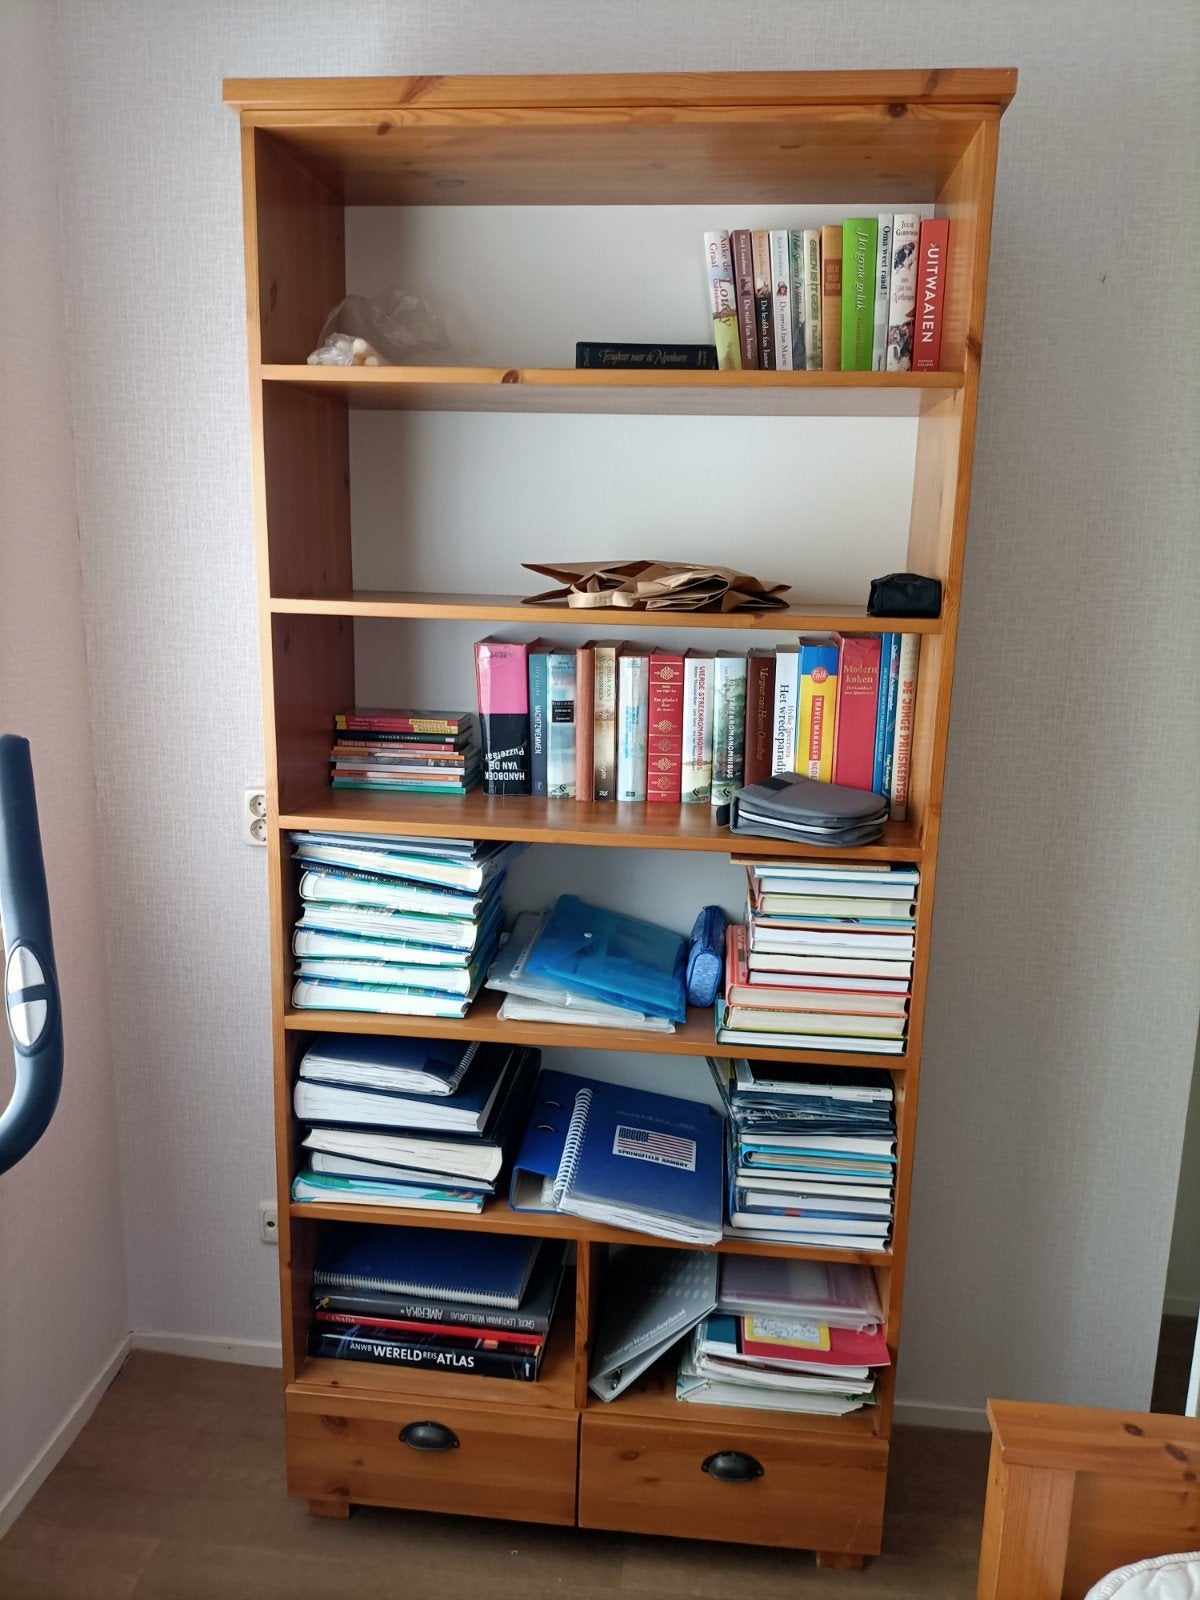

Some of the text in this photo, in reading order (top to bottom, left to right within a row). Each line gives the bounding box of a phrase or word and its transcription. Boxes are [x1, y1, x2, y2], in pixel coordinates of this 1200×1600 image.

[881, 226, 891, 247] Oma
[709, 242, 720, 269] Graaf
[719, 235, 734, 273] Anke de
[809, 239, 818, 270] GRIEN
[881, 248, 889, 268] weet
[855, 254, 865, 280] grote
[880, 269, 888, 290] raad
[743, 299, 752, 310] De
[855, 282, 867, 312] geluk
[922, 247, 940, 343] UITWAAIEN
[779, 300, 787, 311] De
[745, 324, 754, 336] fan
[760, 299, 772, 369] De leafdes fan Janne
[781, 332, 789, 344] fan
[598, 655, 606, 702] WAGENINGEN
[605, 658, 615, 699] GERDA VAN
[812, 670, 827, 681] Falk
[843, 664, 877, 673] Modern
[846, 674, 873, 684] koken
[902, 680, 914, 695] DE
[779, 684, 790, 704] Het
[697, 665, 706, 771] VIERDE STREEKROMANOMNIBUS
[900, 698, 912, 732] JONGE
[533, 705, 543, 754] NACHTZWEMMEN
[785, 706, 795, 758] Hylke Speerstra
[810, 697, 822, 780] TRAVELMANAGER NEDE
[485, 746, 525, 761] Puzzelaar
[773, 738, 787, 775] paradij
[484, 771, 526, 781] HANDBOEK
[502, 761, 518, 771] VAN
[617, 1149, 660, 1162] SPRINGFIELD
[325, 1315, 356, 1324] CANADA
[405, 1306, 443, 1320] AMERIKA
[449, 1311, 486, 1324] WERELDATLAS
[517, 1318, 535, 1329] GROTE
[350, 1342, 373, 1352] ANWB
[373, 1344, 422, 1362] WERELD
[436, 1354, 475, 1368] ATLAS
